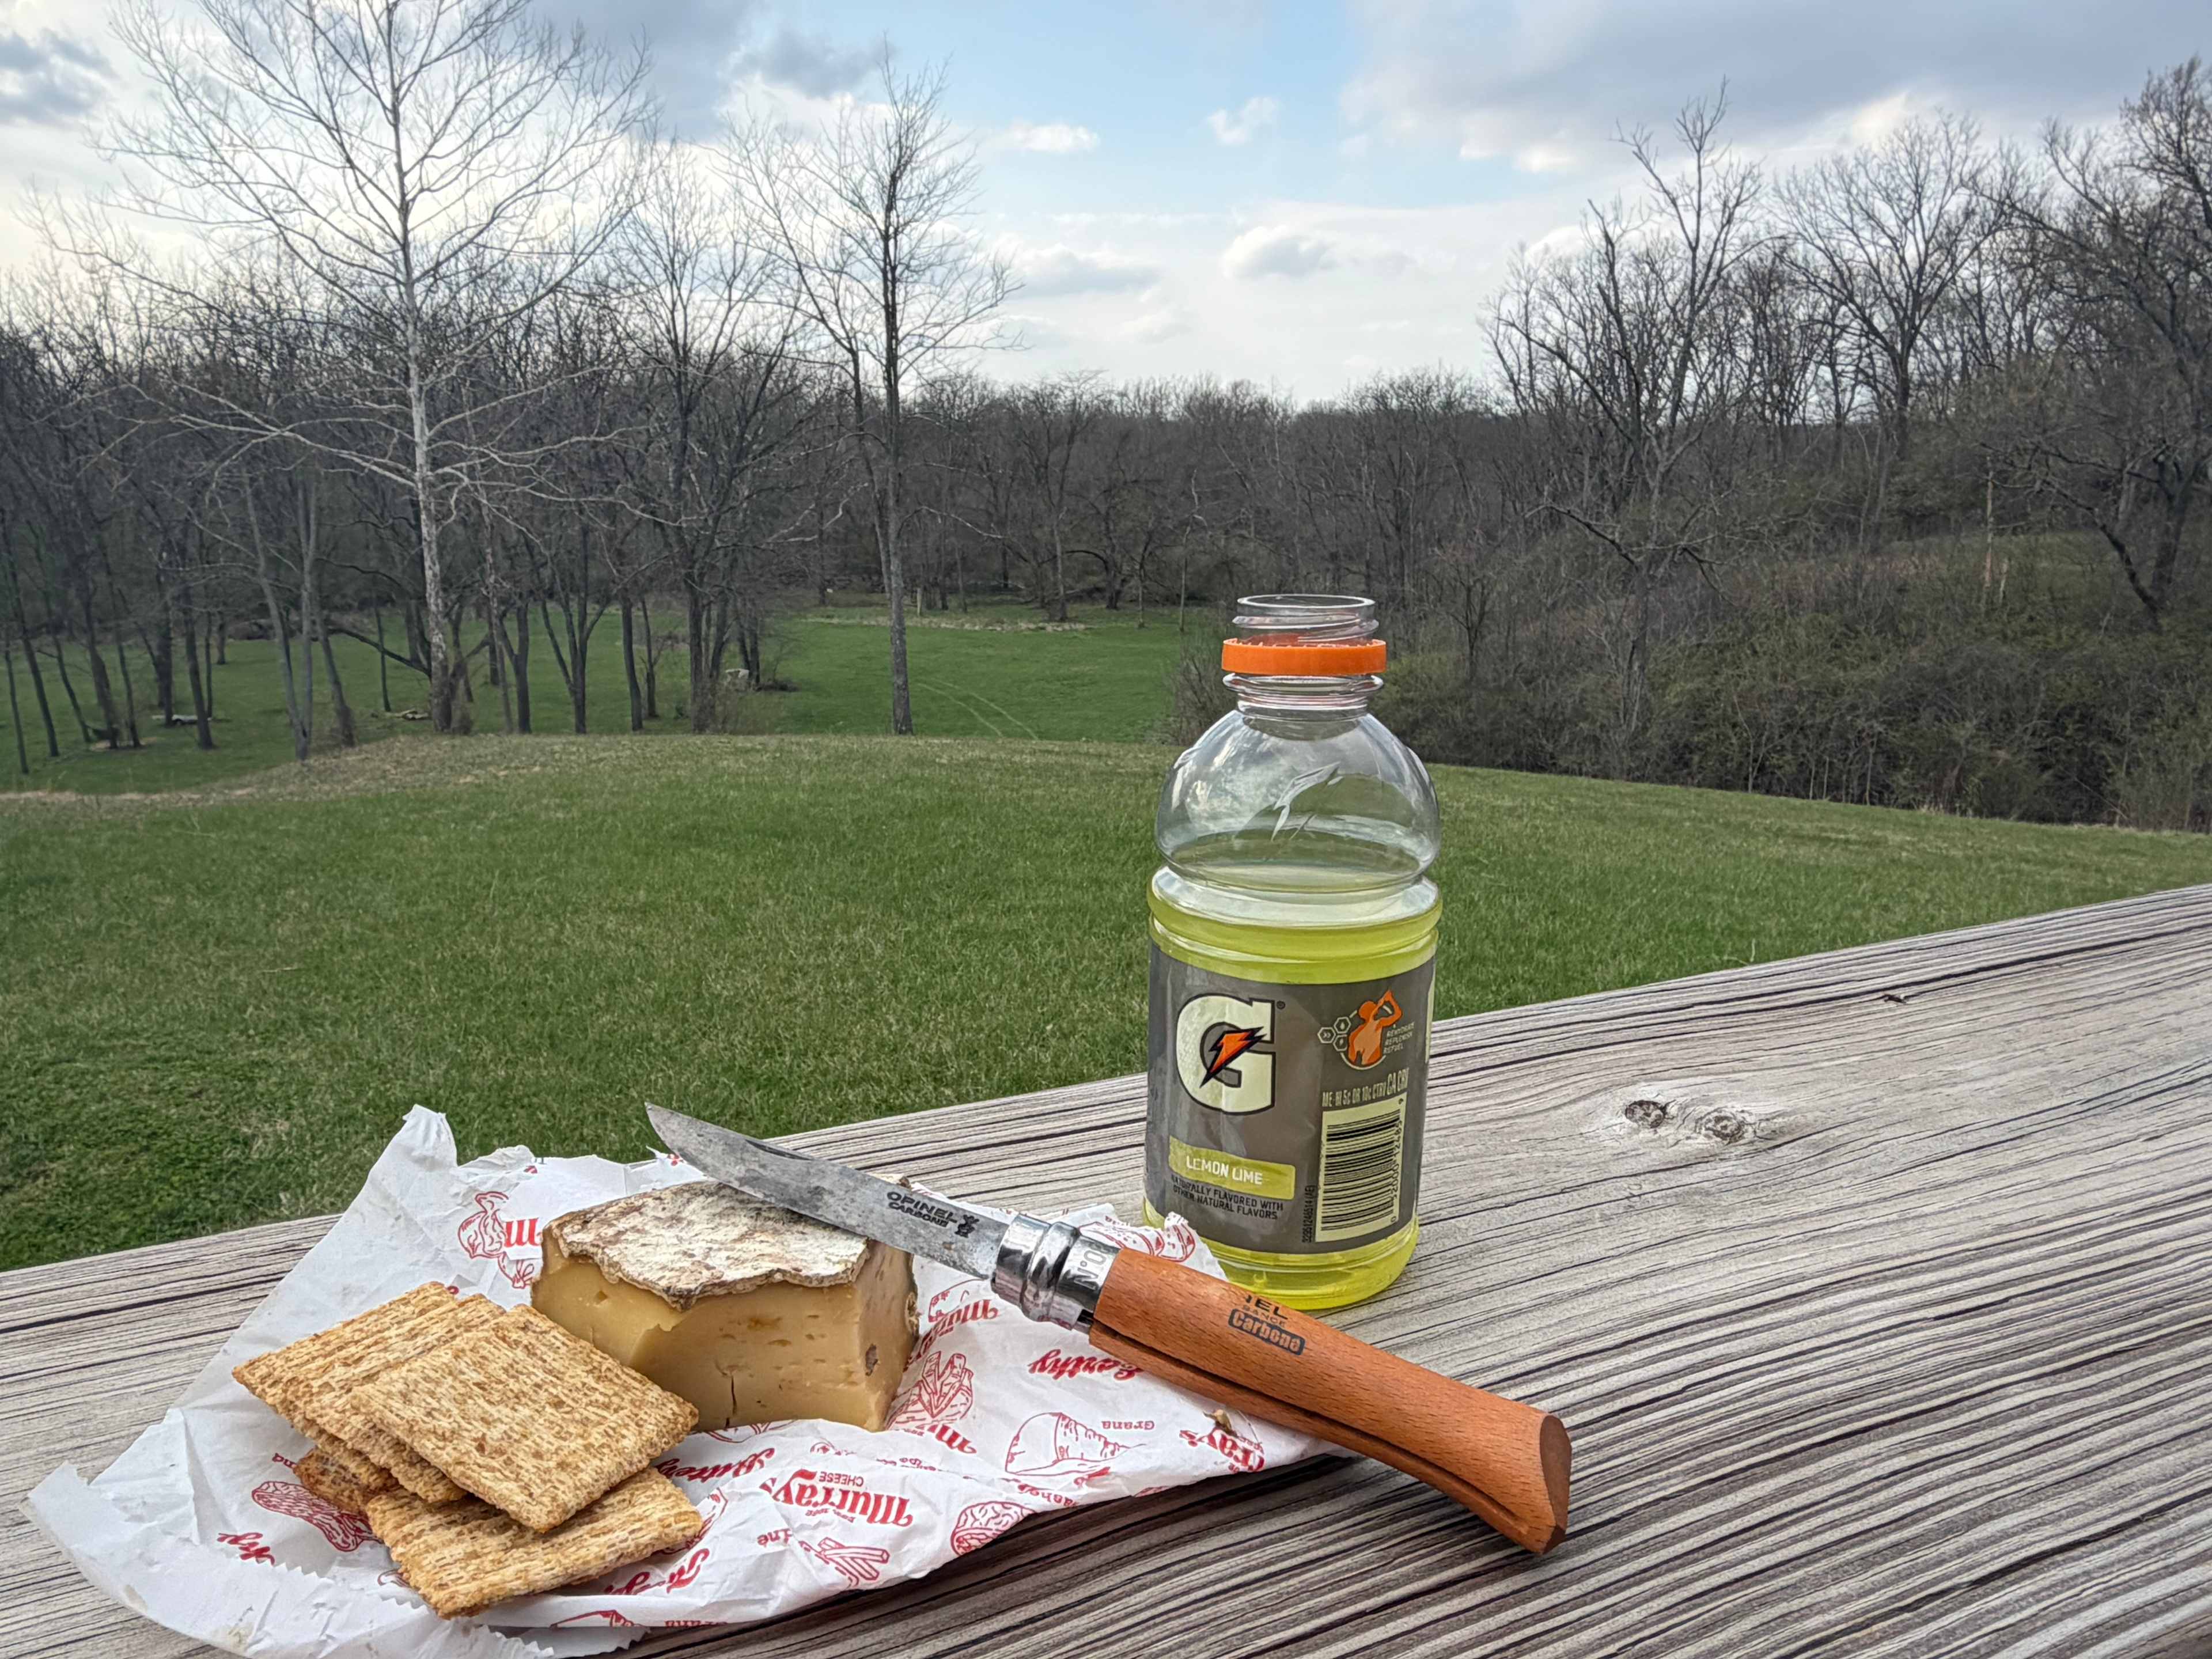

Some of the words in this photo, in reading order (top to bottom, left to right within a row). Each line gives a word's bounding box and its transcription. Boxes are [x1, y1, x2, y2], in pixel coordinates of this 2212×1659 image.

[1176, 992, 1276, 1116] G
[1187, 1156, 1229, 1178] LEMON
[1232, 1166, 1264, 1185] LIME
[887, 1191, 957, 1224] OPINEL
[1171, 1175, 1211, 1195] NATURALLY
[1214, 1188, 1257, 1207] FLAVORED
[1260, 1199, 1283, 1211] WITH
[1173, 1184, 1195, 1202] OTHER
[1196, 1194, 1235, 1213] NATURAL
[1237, 1206, 1278, 1219] FLAVORS
[888, 1202, 949, 1228] CARBONE
[1232, 1309, 1301, 1352] Carbone
[1028, 1349, 1143, 1381] Earthy
[1101, 1420, 1156, 1431] Grana
[818, 1471, 865, 1488] CHEESE
